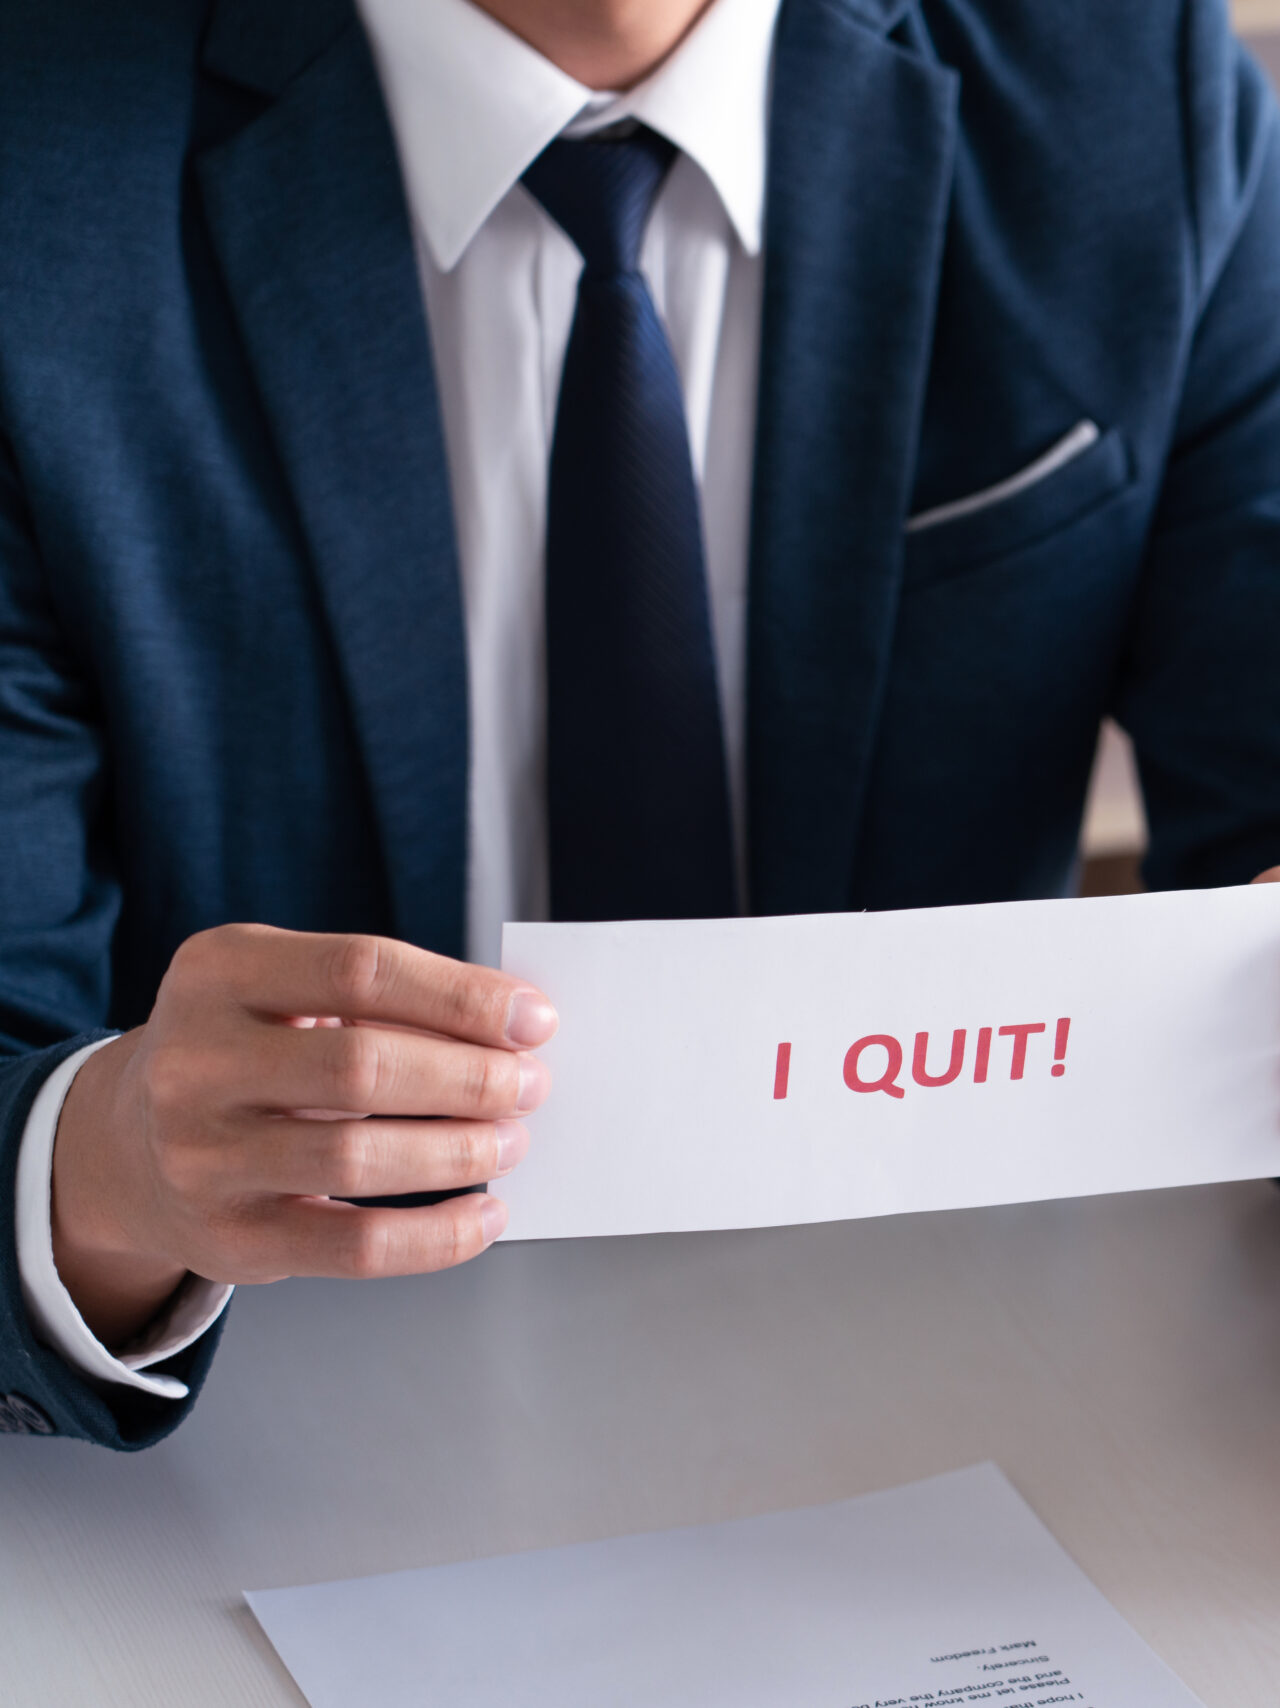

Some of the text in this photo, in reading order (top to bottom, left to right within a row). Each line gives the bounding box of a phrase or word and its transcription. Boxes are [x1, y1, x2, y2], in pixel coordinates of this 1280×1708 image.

[773, 1017, 1071, 1099] I QUIT!
[930, 1640, 1038, 1663] Mark Freedom
[874, 1669, 1062, 1708] and the company the very
[924, 1678, 1071, 1708] Please let me know
[1036, 1694, 1076, 1705] hope
